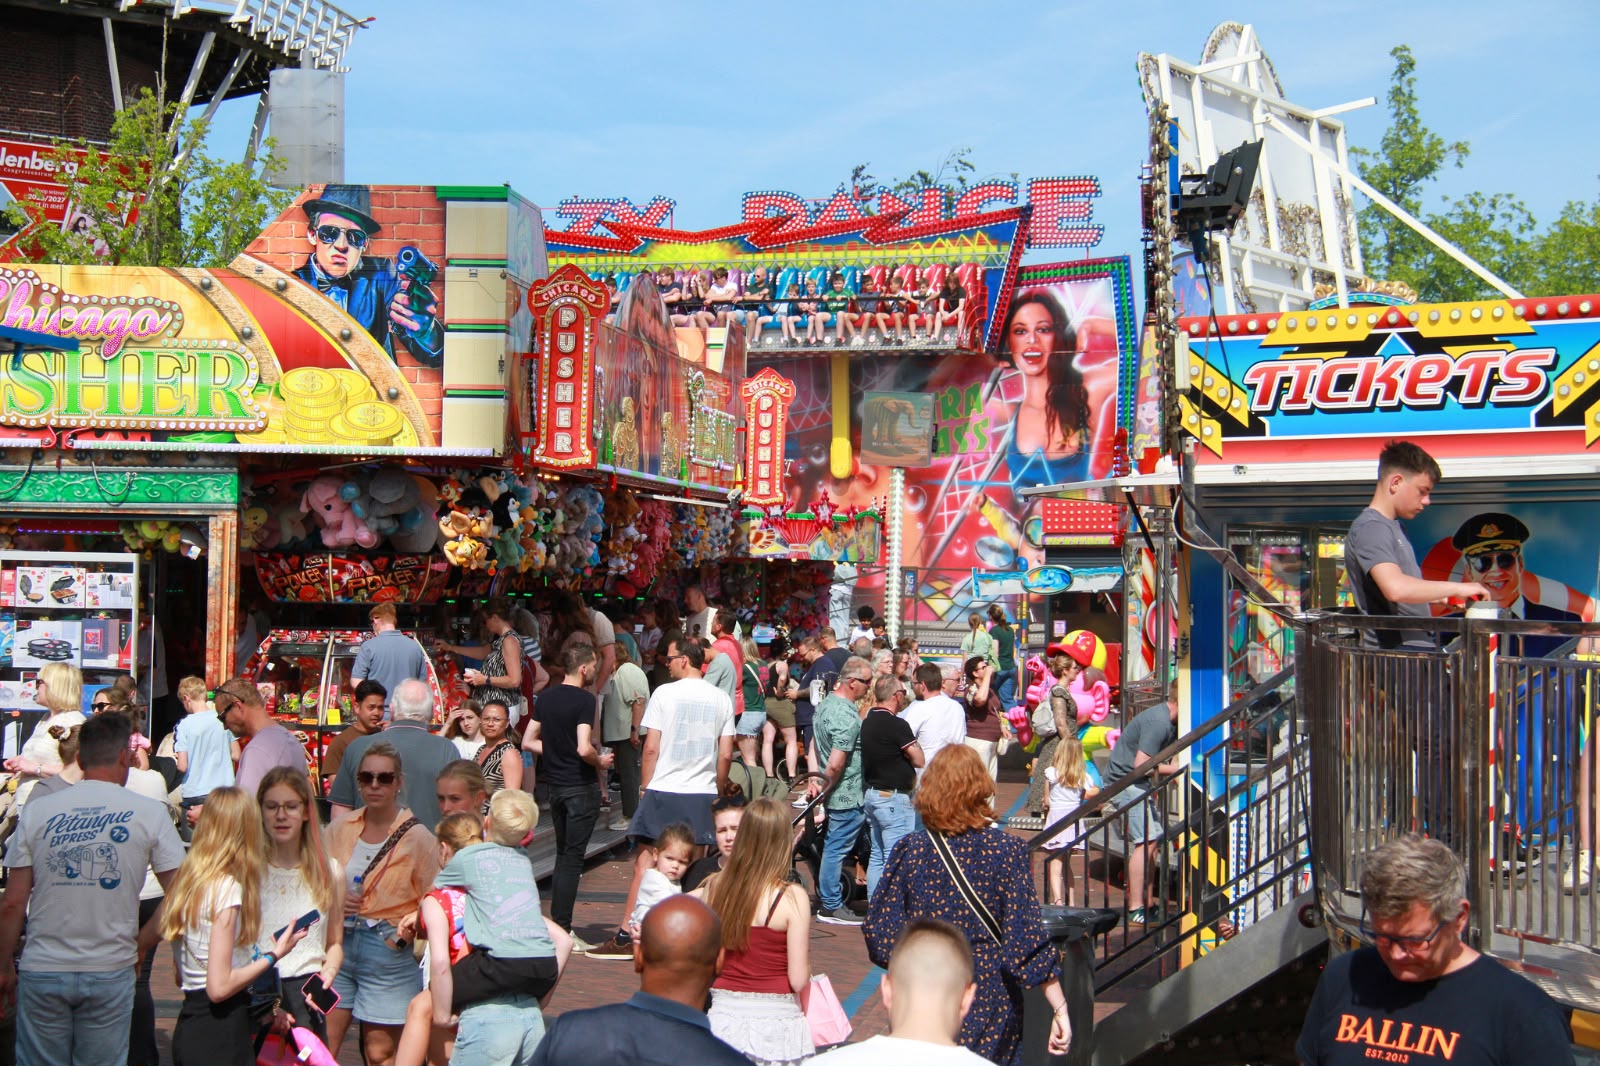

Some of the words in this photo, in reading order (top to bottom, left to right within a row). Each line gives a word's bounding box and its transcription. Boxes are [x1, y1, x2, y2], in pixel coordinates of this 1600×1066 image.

[742, 175, 1105, 249] DANCE
[541, 283, 597, 303] CHICAGO
[553, 307, 577, 453] PUSHER
[748, 381, 787, 394] CHICAGO
[757, 396, 773, 495] PUSHER
[273, 567, 323, 597] POKER
[348, 569, 416, 597] POKER
[42, 810, 134, 840] Pétanque
[50, 830, 98, 848] EXPRESS
[1335, 1014, 1460, 1060] BALLIN
